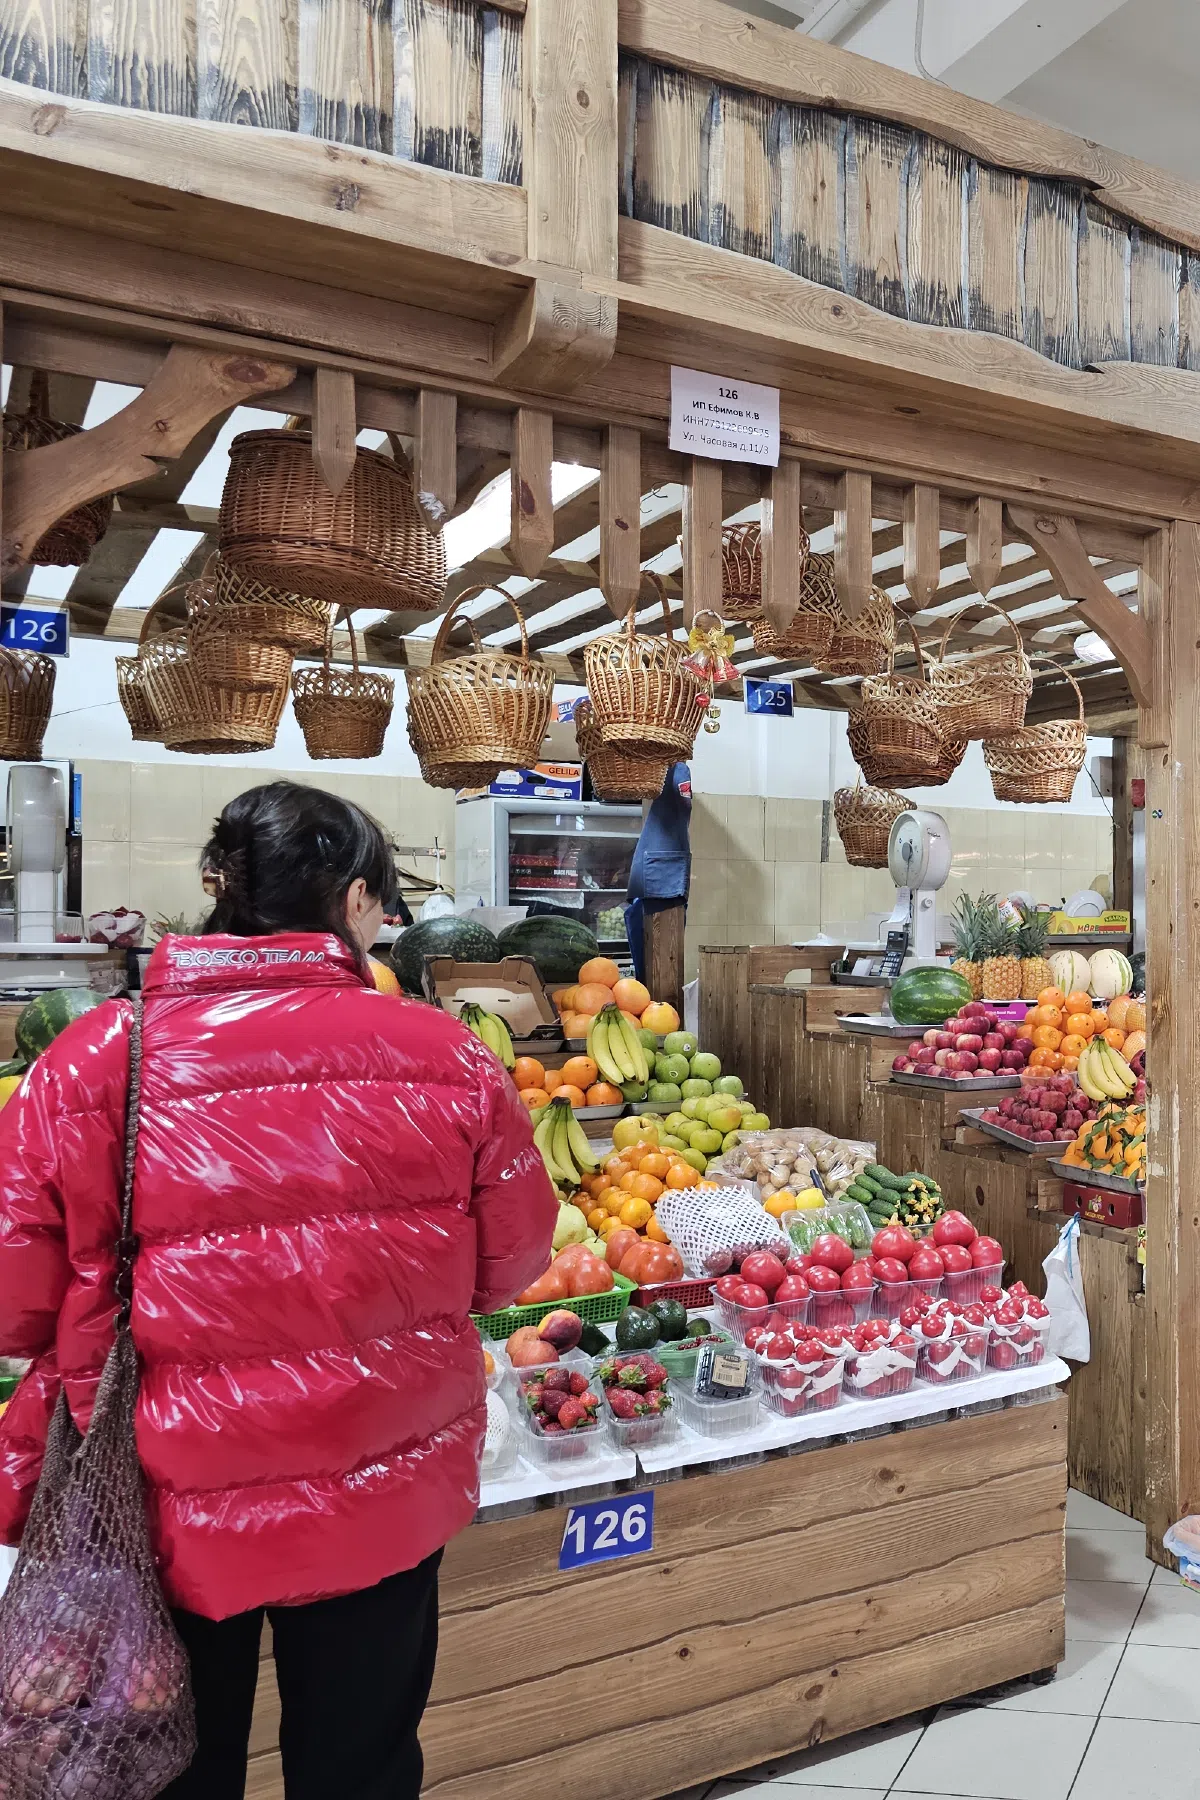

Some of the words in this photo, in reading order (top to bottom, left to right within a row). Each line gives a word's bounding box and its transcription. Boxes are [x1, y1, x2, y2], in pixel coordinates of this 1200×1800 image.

[718, 387, 738, 400] 126
[692, 401, 706, 410] ИП
[708, 403, 743, 417] Ефимов
[683, 431, 698, 442] Ул.
[700, 434, 738, 449] Часовая
[6, 618, 58, 643] 126
[754, 688, 786, 706] 125
[548, 767, 580, 776] GELILA
[171, 949, 258, 967] BOSCO
[258, 948, 325, 964] TEAM
[567, 1503, 647, 1555] 126
